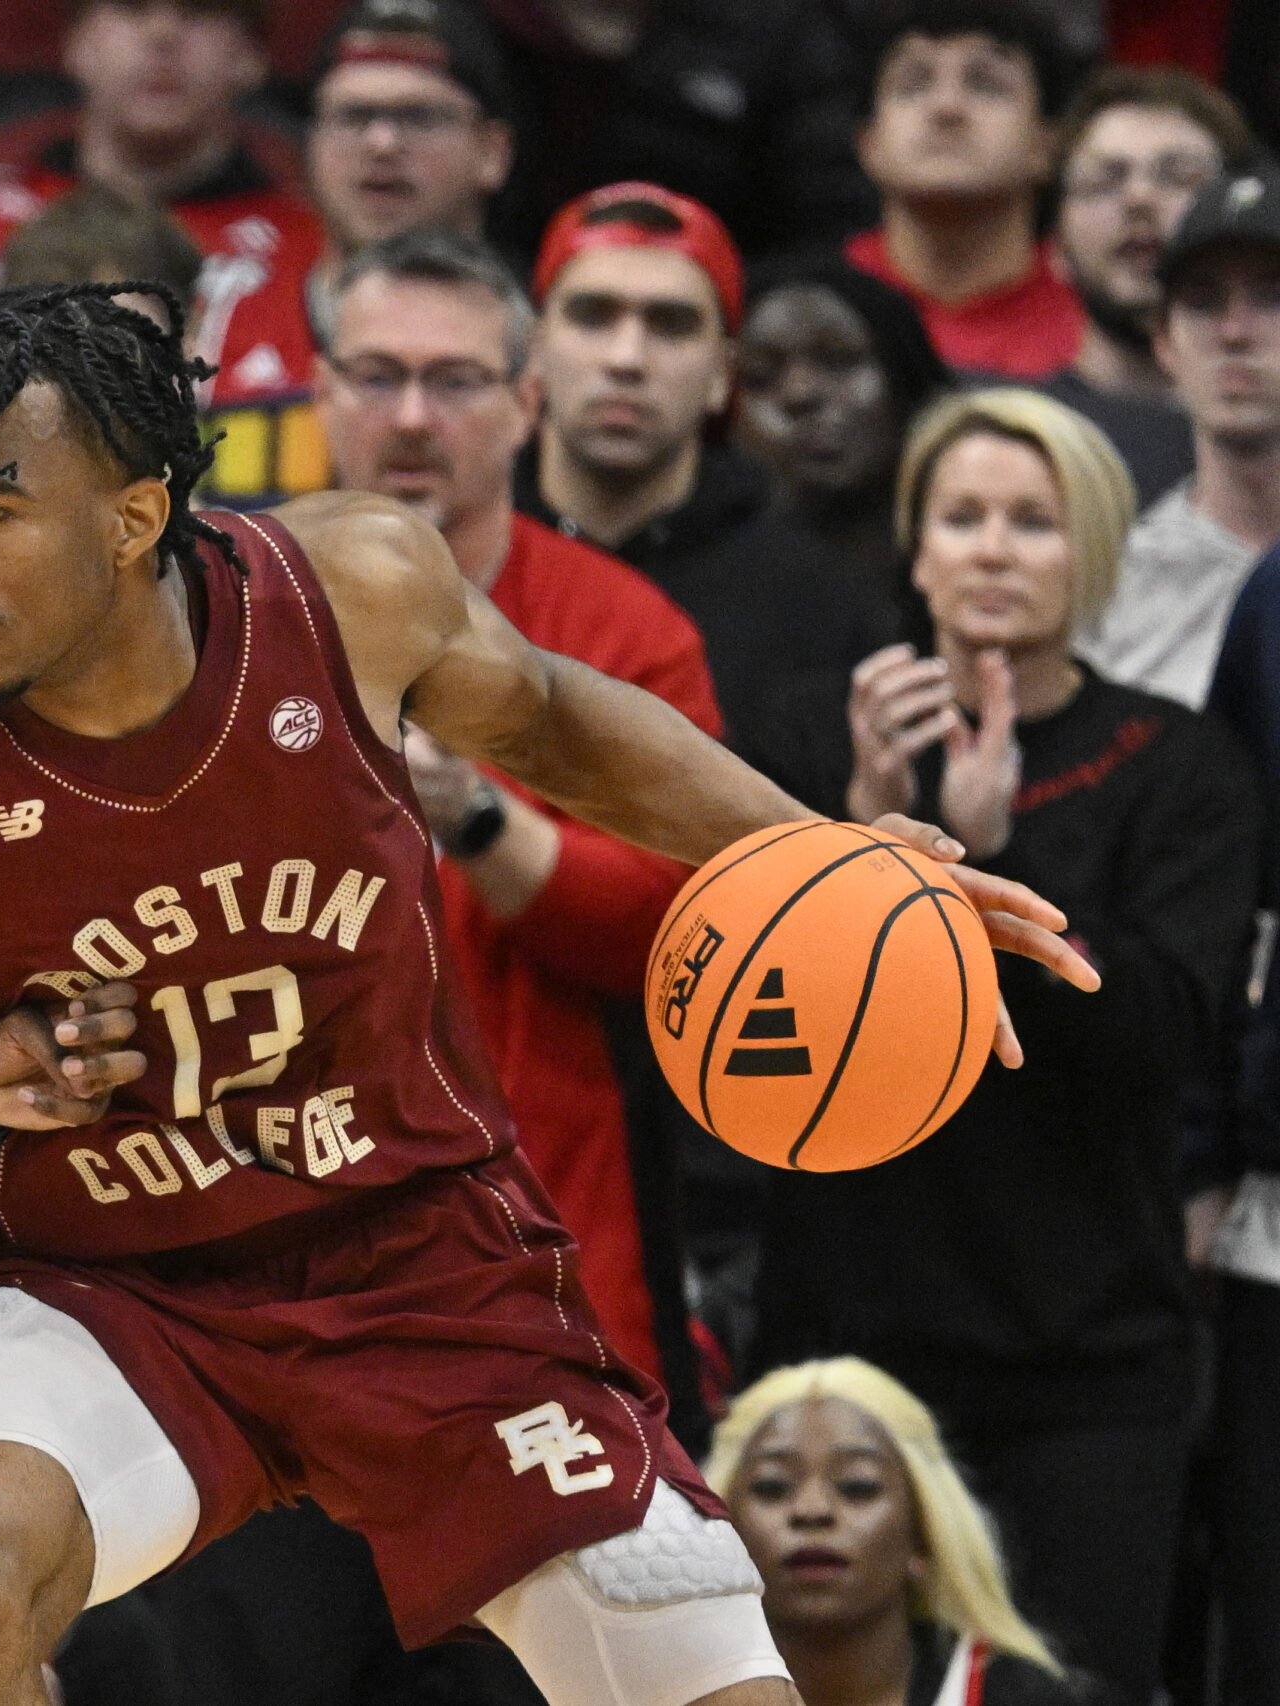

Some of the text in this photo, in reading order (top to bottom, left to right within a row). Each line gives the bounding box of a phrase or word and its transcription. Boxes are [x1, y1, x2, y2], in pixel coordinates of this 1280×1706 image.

[276, 706, 318, 737] ACC
[23, 859, 387, 998] BOSTON
[664, 923, 725, 1041] PRO
[151, 964, 304, 1119] 13
[68, 1085, 376, 1204] COLLEGE
[493, 1400, 615, 1496] BC
